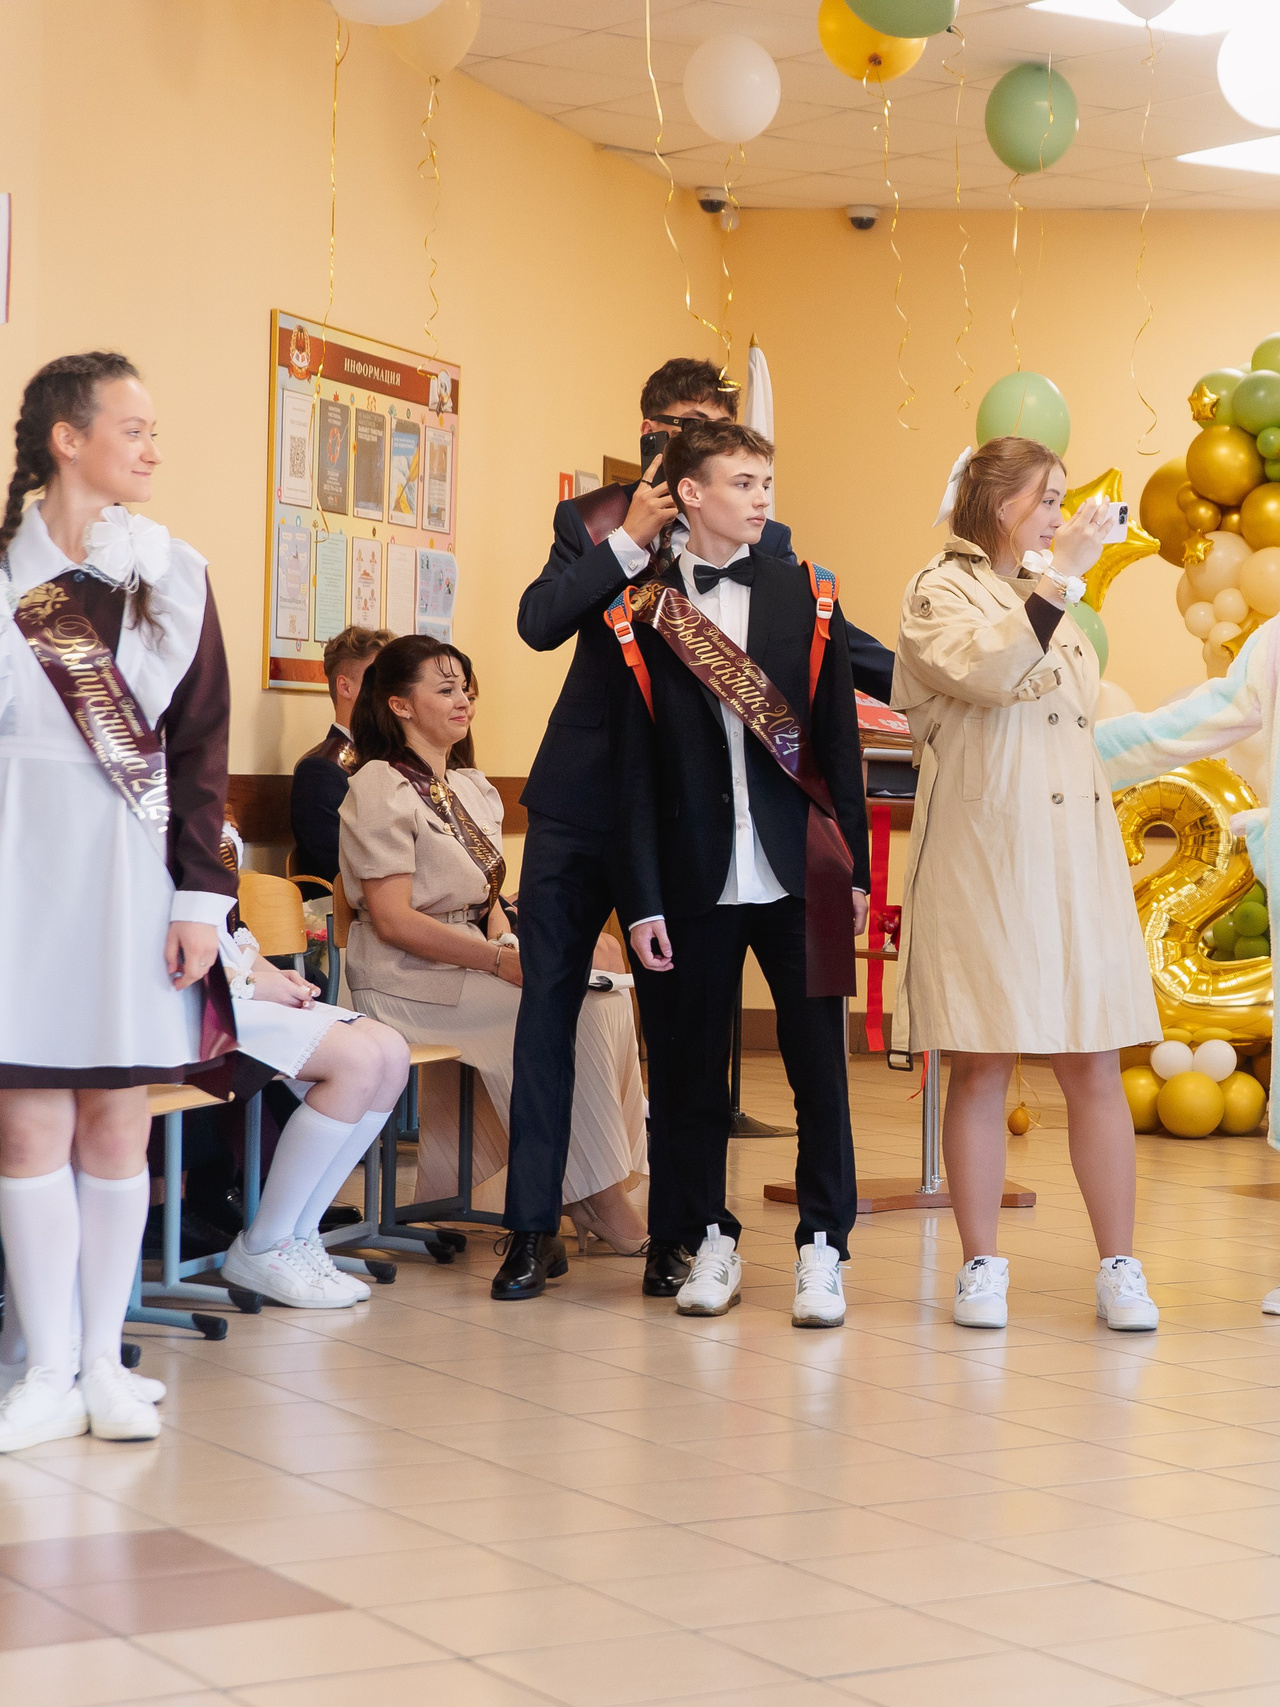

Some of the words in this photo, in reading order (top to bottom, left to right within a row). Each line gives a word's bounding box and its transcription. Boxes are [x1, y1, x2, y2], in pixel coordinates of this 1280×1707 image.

[344, 357, 401, 387] ИНФОРМАЦИЯ
[43, 614, 149, 776] Выпускница
[658, 595, 769, 713] Выпускник
[758, 704, 802, 756] 2024
